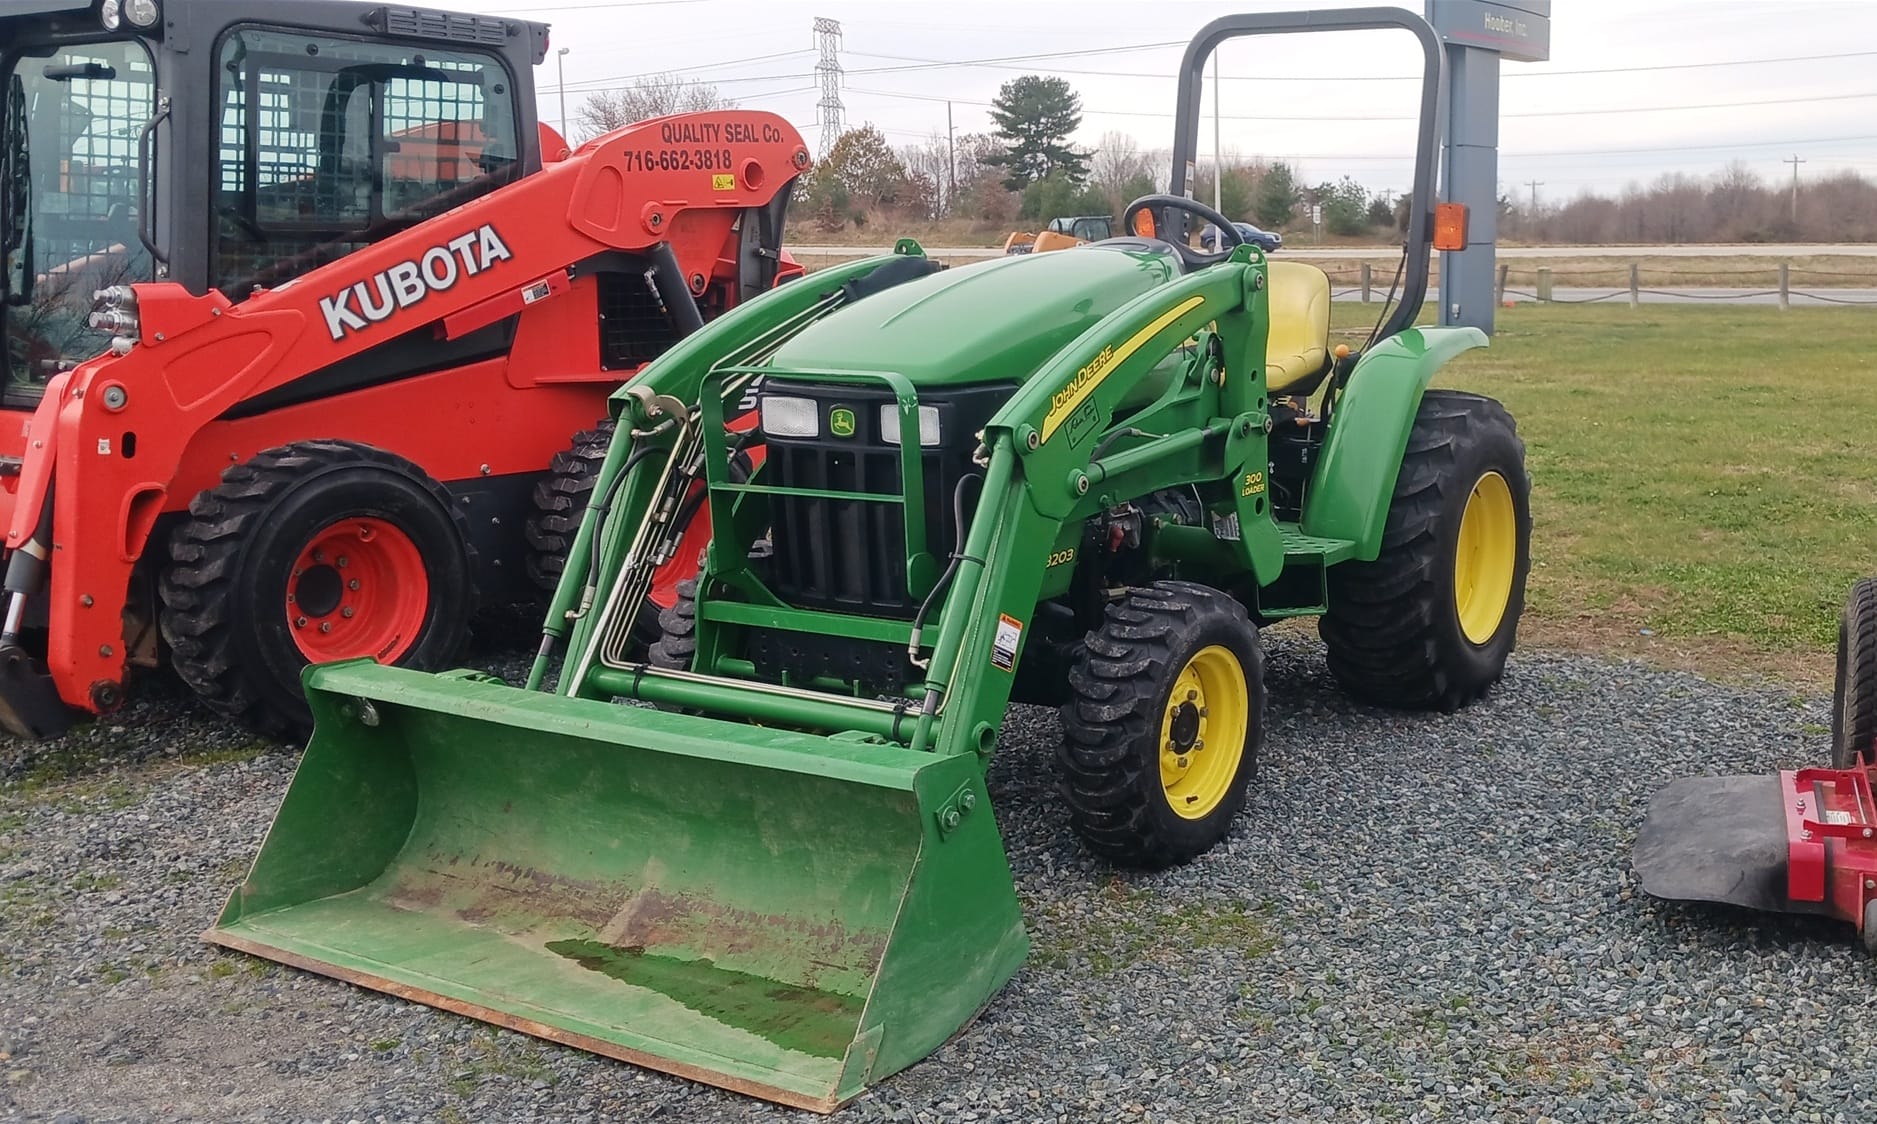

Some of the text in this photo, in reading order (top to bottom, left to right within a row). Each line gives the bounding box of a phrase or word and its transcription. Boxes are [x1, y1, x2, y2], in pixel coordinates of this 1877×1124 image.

[661, 123, 784, 145] QUALITY SEAL Co.
[624, 149, 732, 172] 716-662-3818
[318, 224, 512, 340] KUBOTA
[1049, 379, 1080, 417] JOHN
[1077, 343, 1115, 388] DEERE
[1244, 471, 1262, 486] 300
[1241, 483, 1265, 497] LOADER
